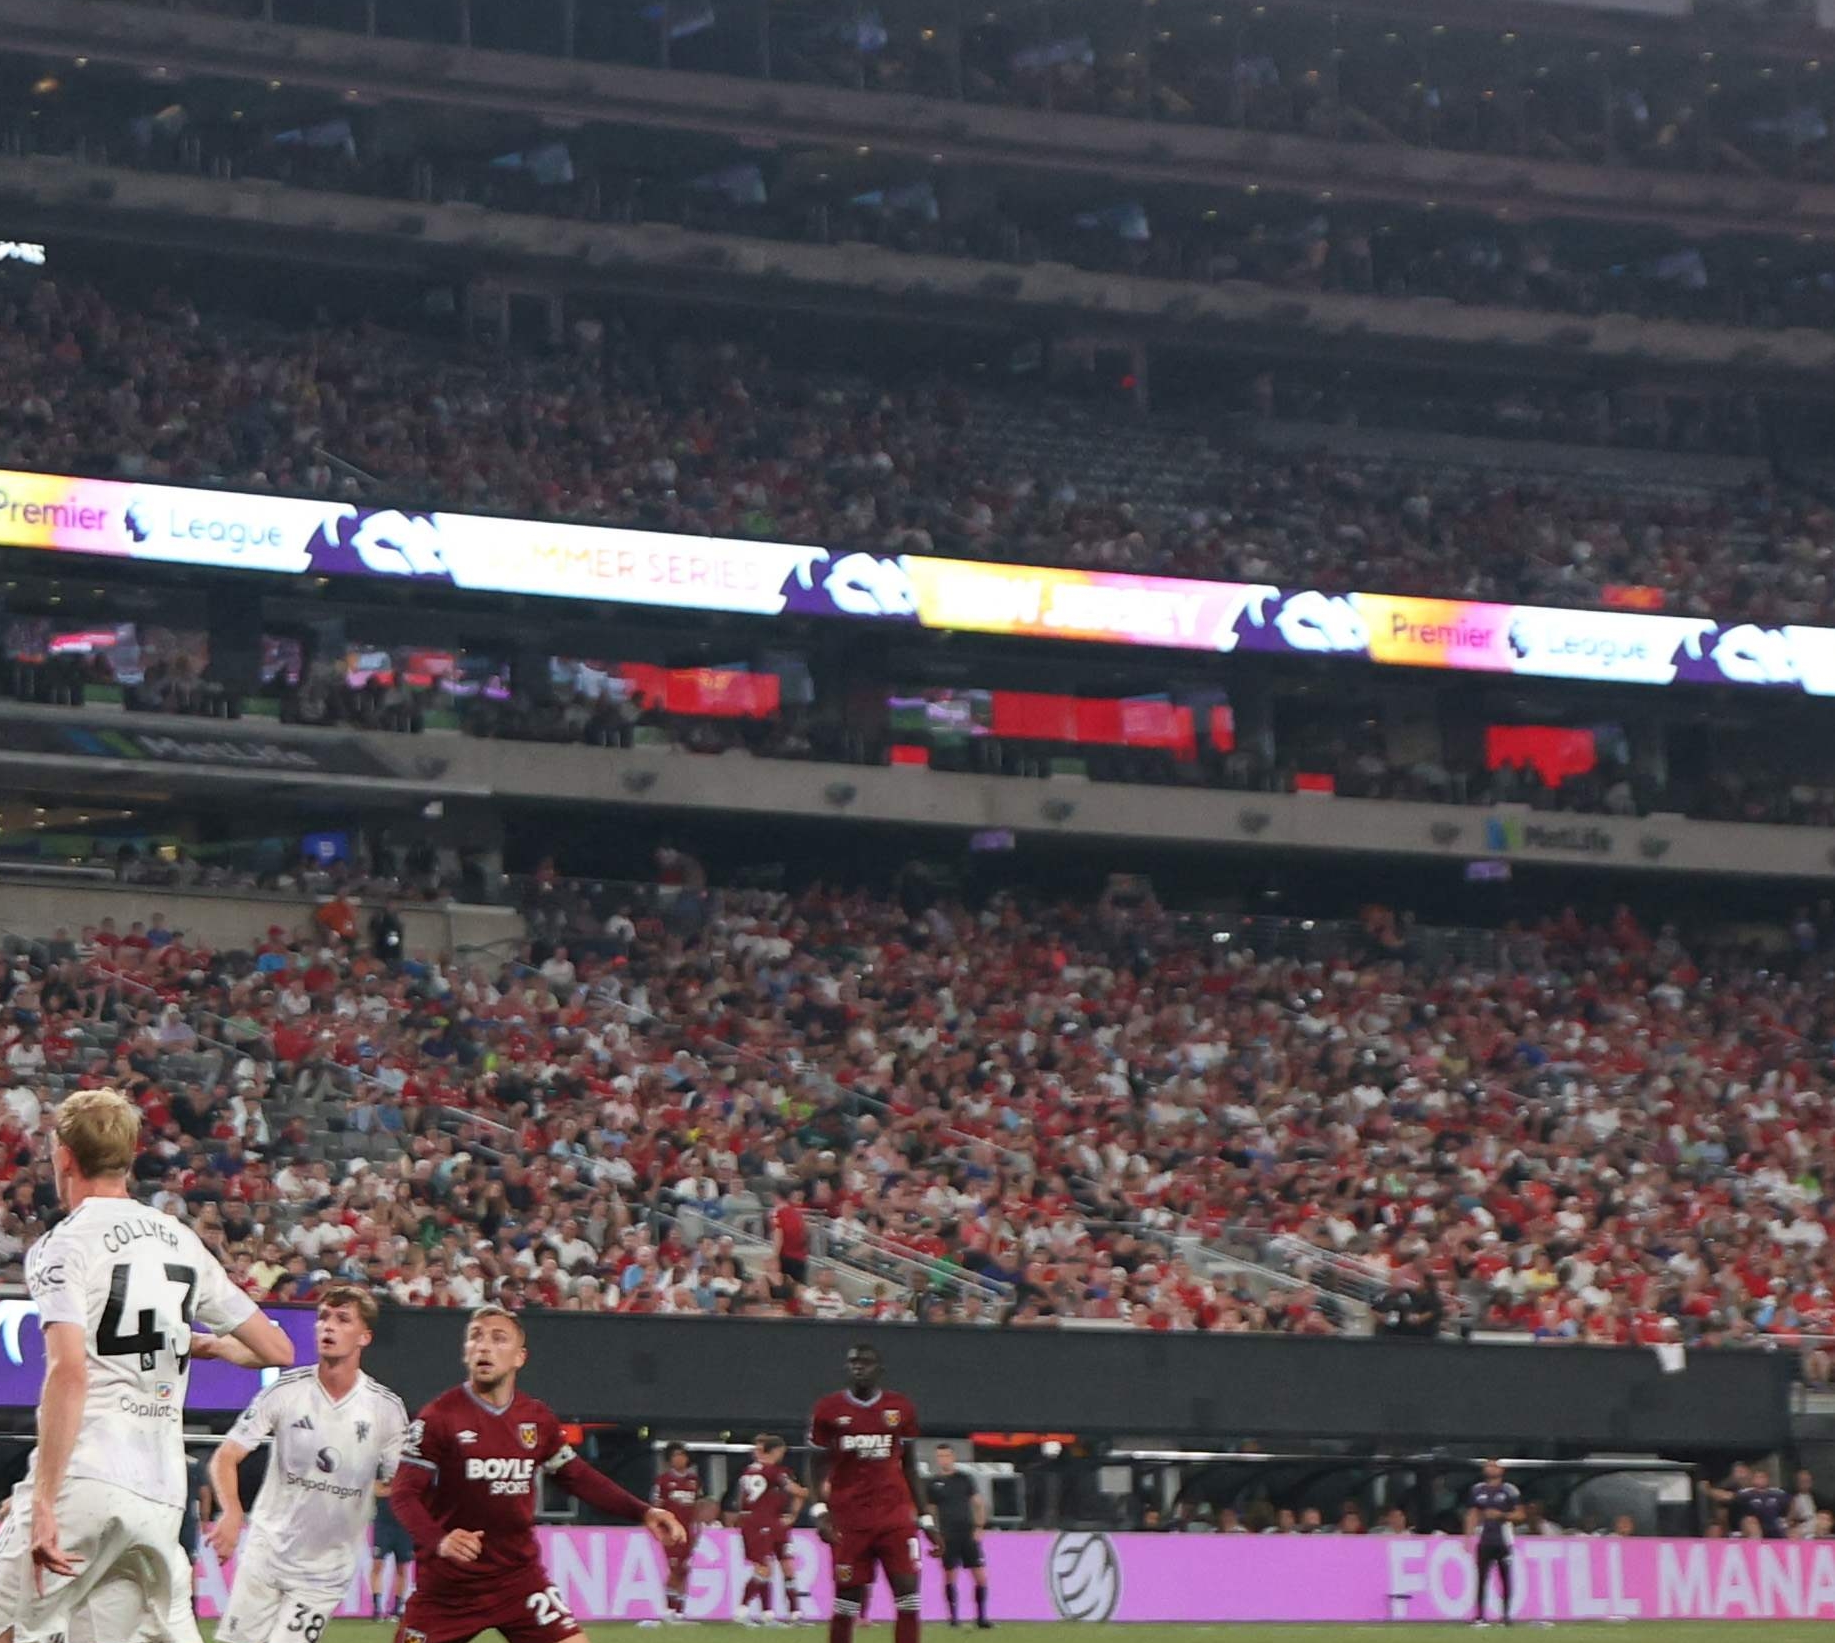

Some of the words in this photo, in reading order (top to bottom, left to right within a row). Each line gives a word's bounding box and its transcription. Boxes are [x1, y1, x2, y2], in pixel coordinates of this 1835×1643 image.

[169, 512, 283, 554] League
[1391, 612, 1495, 649] Premier
[103, 1218, 180, 1255] COLLYER
[285, 1470, 363, 1501] Snapdragon
[465, 1457, 535, 1481] BOYLE
[286, 1601, 326, 1643] 38
[525, 1585, 572, 1626] 20
